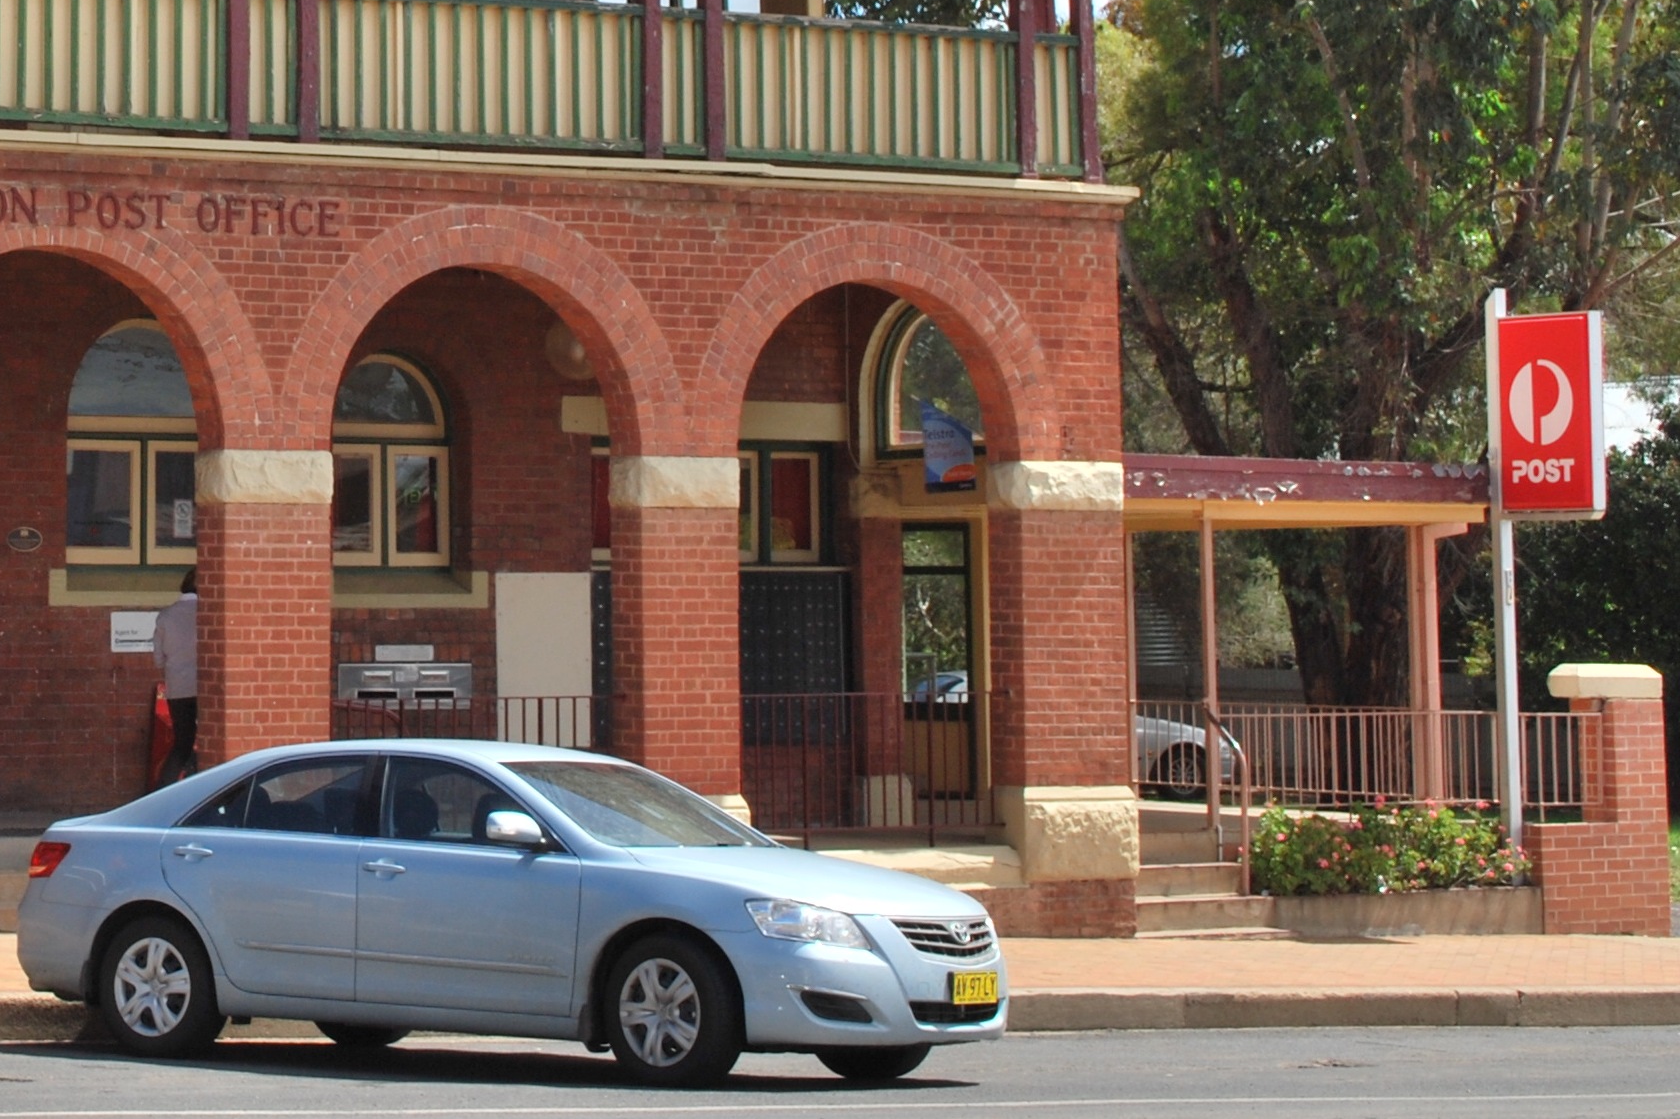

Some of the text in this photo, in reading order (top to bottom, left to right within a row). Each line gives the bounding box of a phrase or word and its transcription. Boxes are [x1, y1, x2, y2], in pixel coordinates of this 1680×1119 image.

[66, 190, 170, 230] POST
[196, 195, 341, 237] OFFICE
[923, 429, 955, 440] Telstra
[1511, 458, 1575, 484] POST
